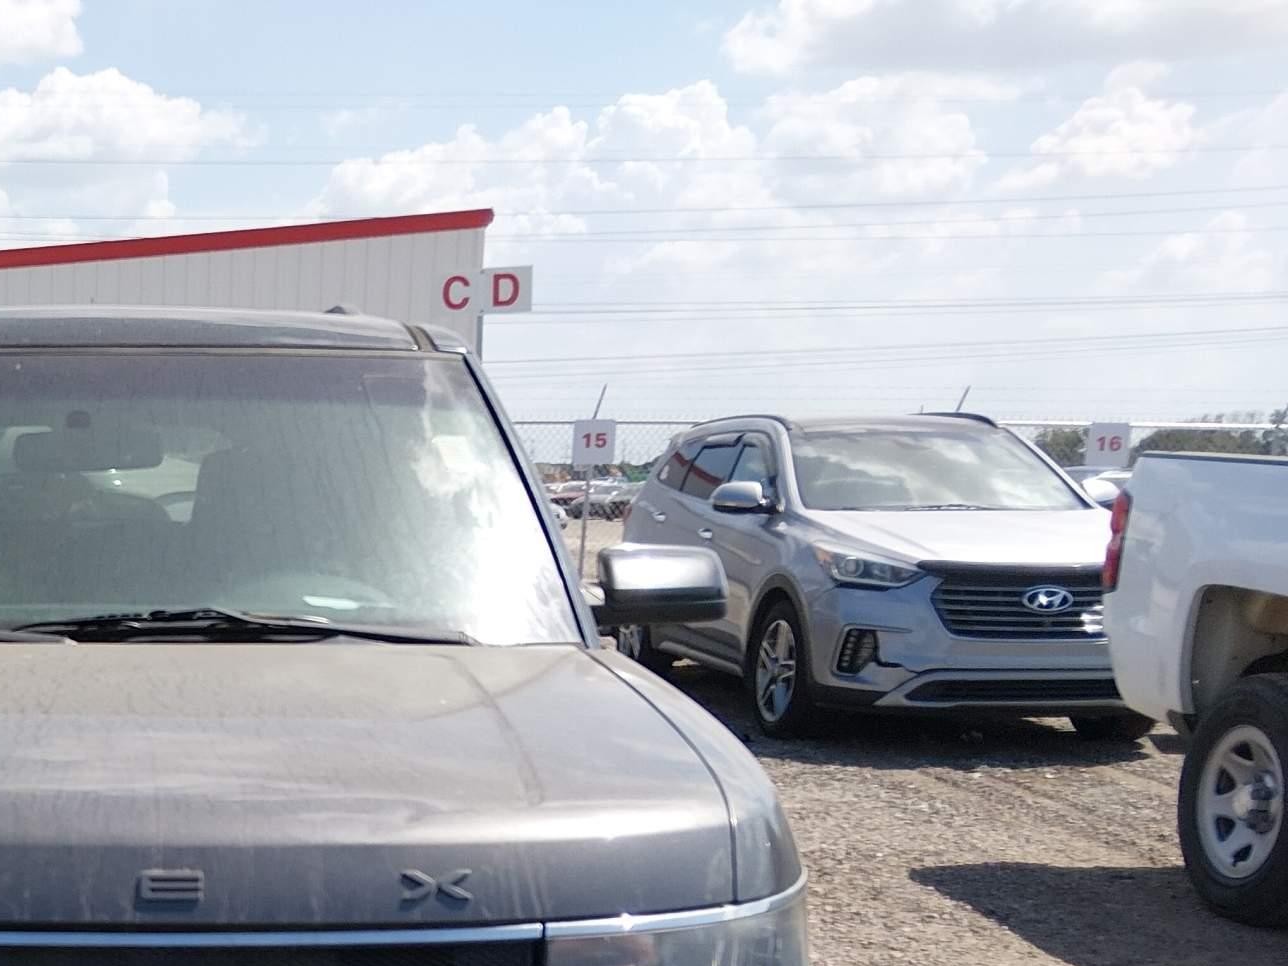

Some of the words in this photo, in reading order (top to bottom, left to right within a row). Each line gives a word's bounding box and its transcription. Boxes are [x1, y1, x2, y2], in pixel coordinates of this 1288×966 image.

[442, 275, 470, 310] C
[492, 273, 520, 307] D
[582, 432, 607, 448] 15
[1096, 435, 1122, 451] 16
